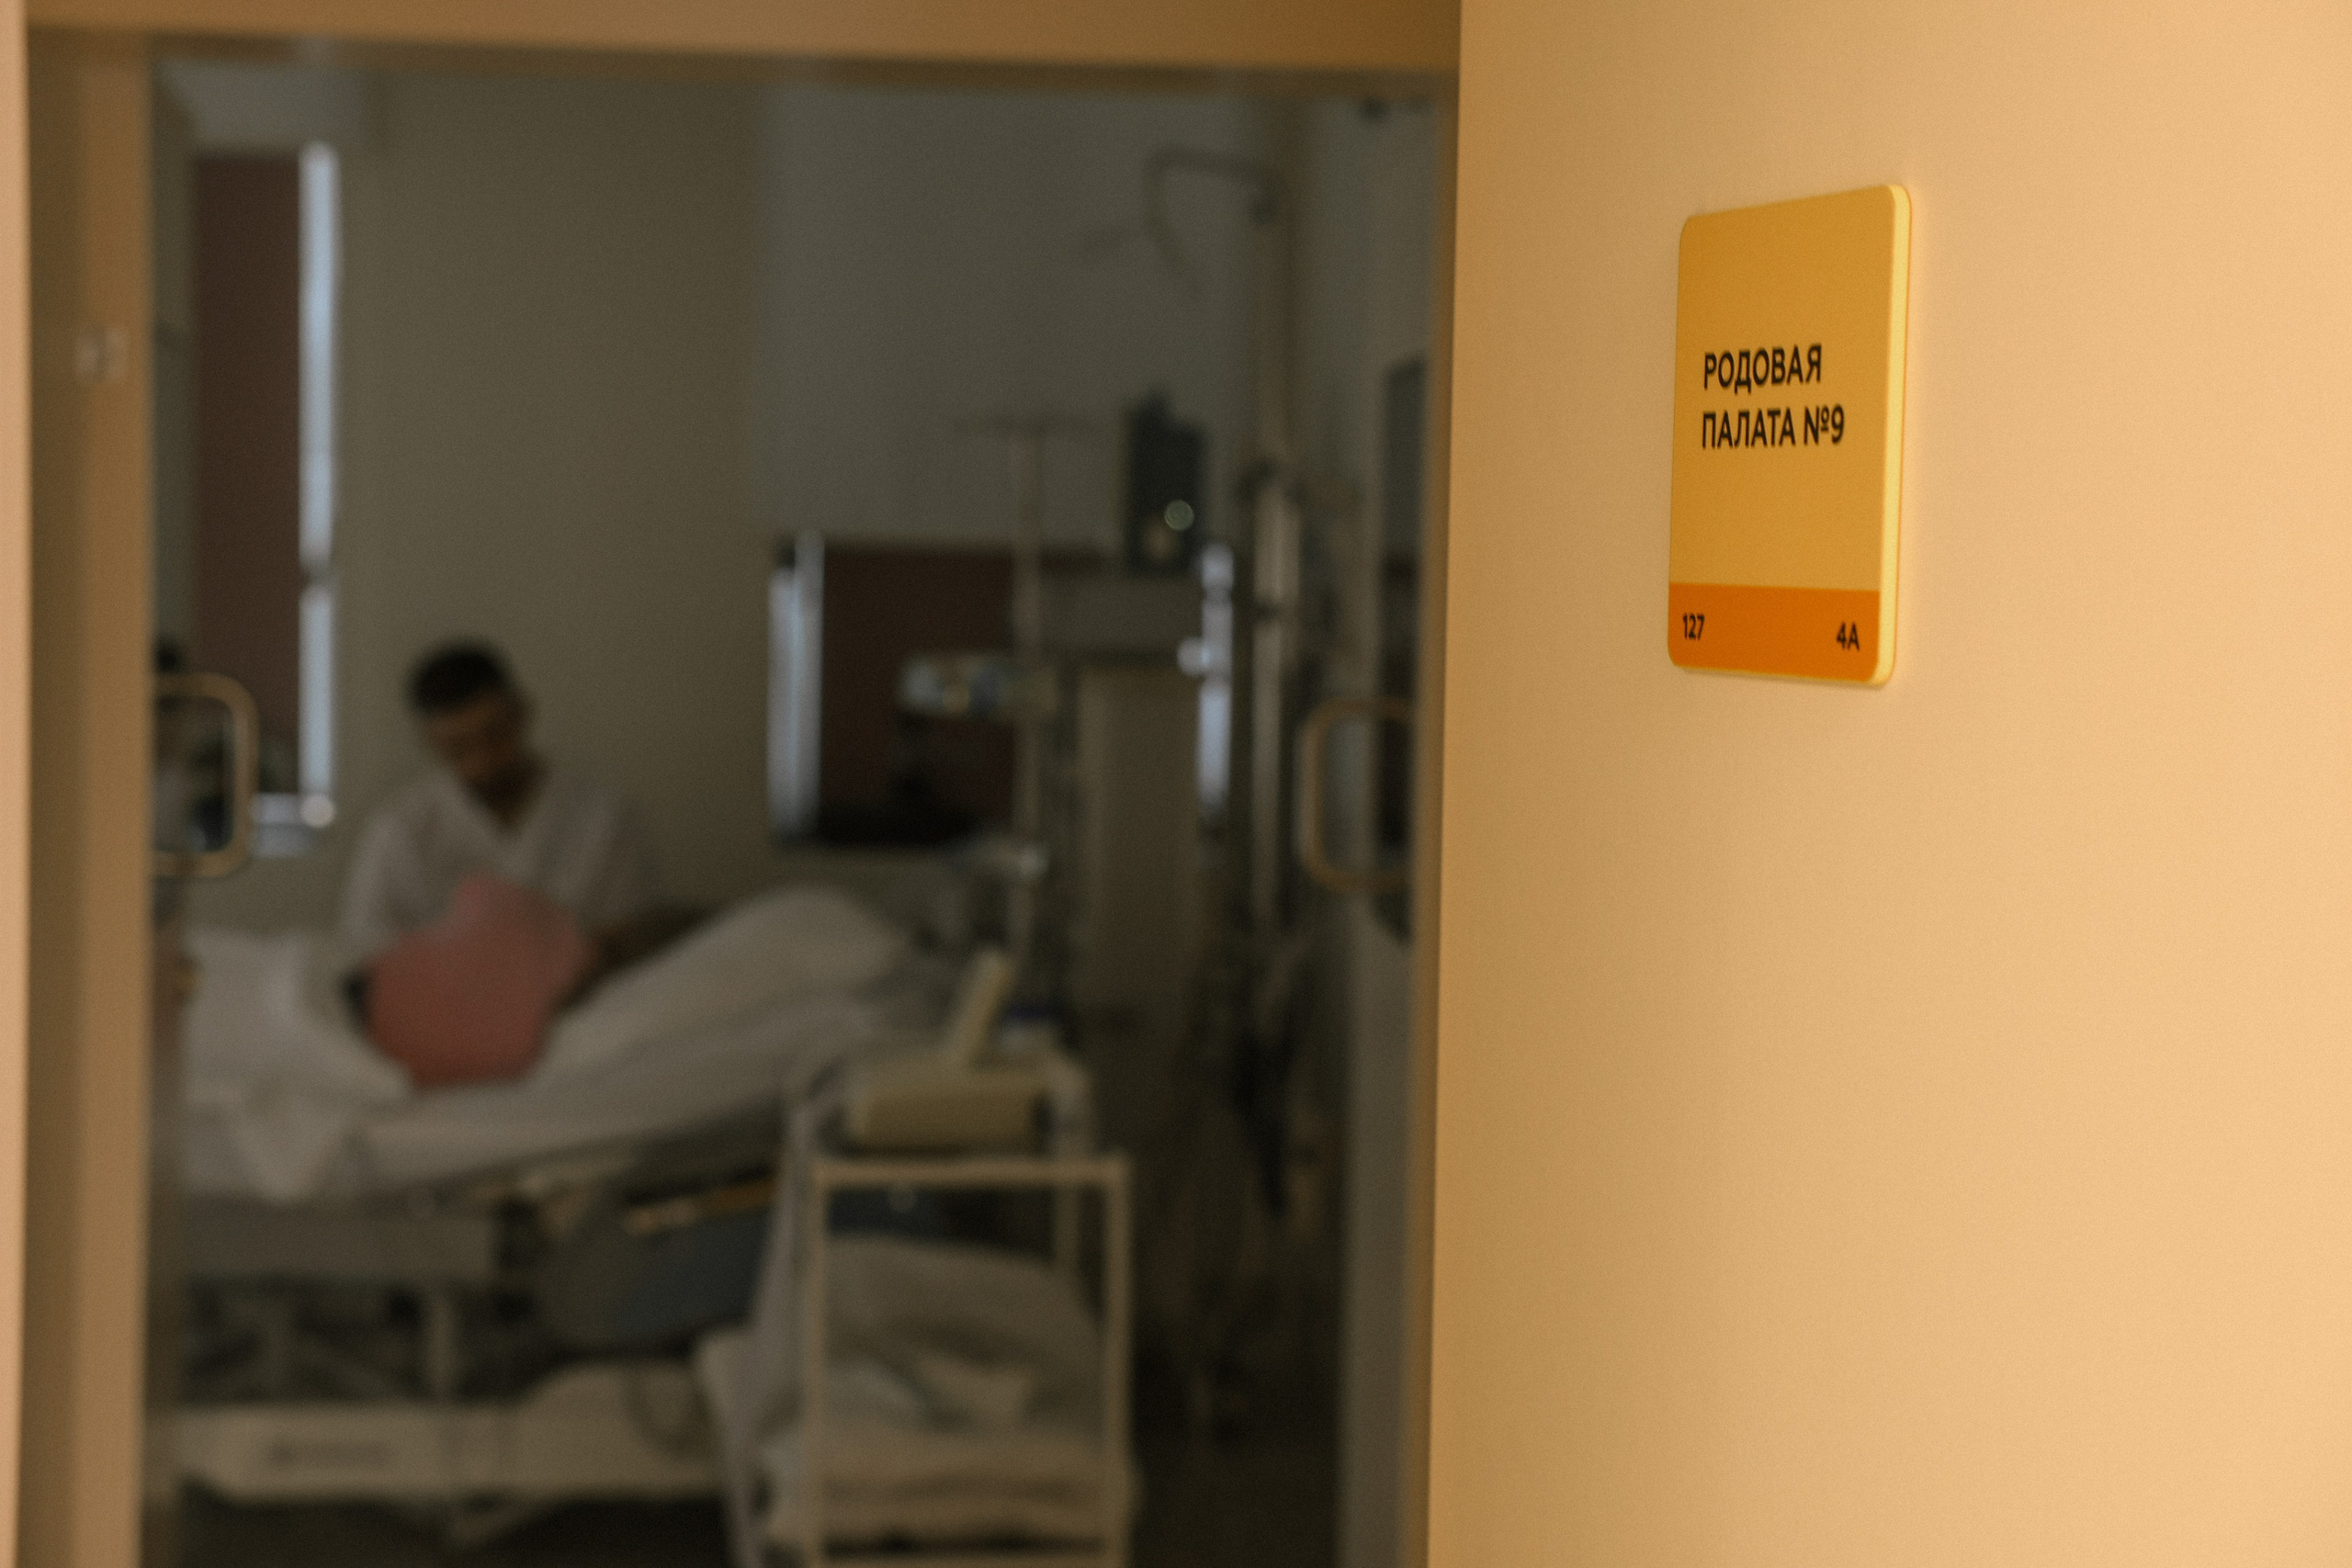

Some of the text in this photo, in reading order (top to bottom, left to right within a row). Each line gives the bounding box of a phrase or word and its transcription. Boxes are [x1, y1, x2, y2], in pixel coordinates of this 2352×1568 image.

[1702, 344, 1823, 395] РОДОВАЯ
[1702, 404, 1846, 449] ПАЛАТА №9
[1682, 613, 1706, 640] 127
